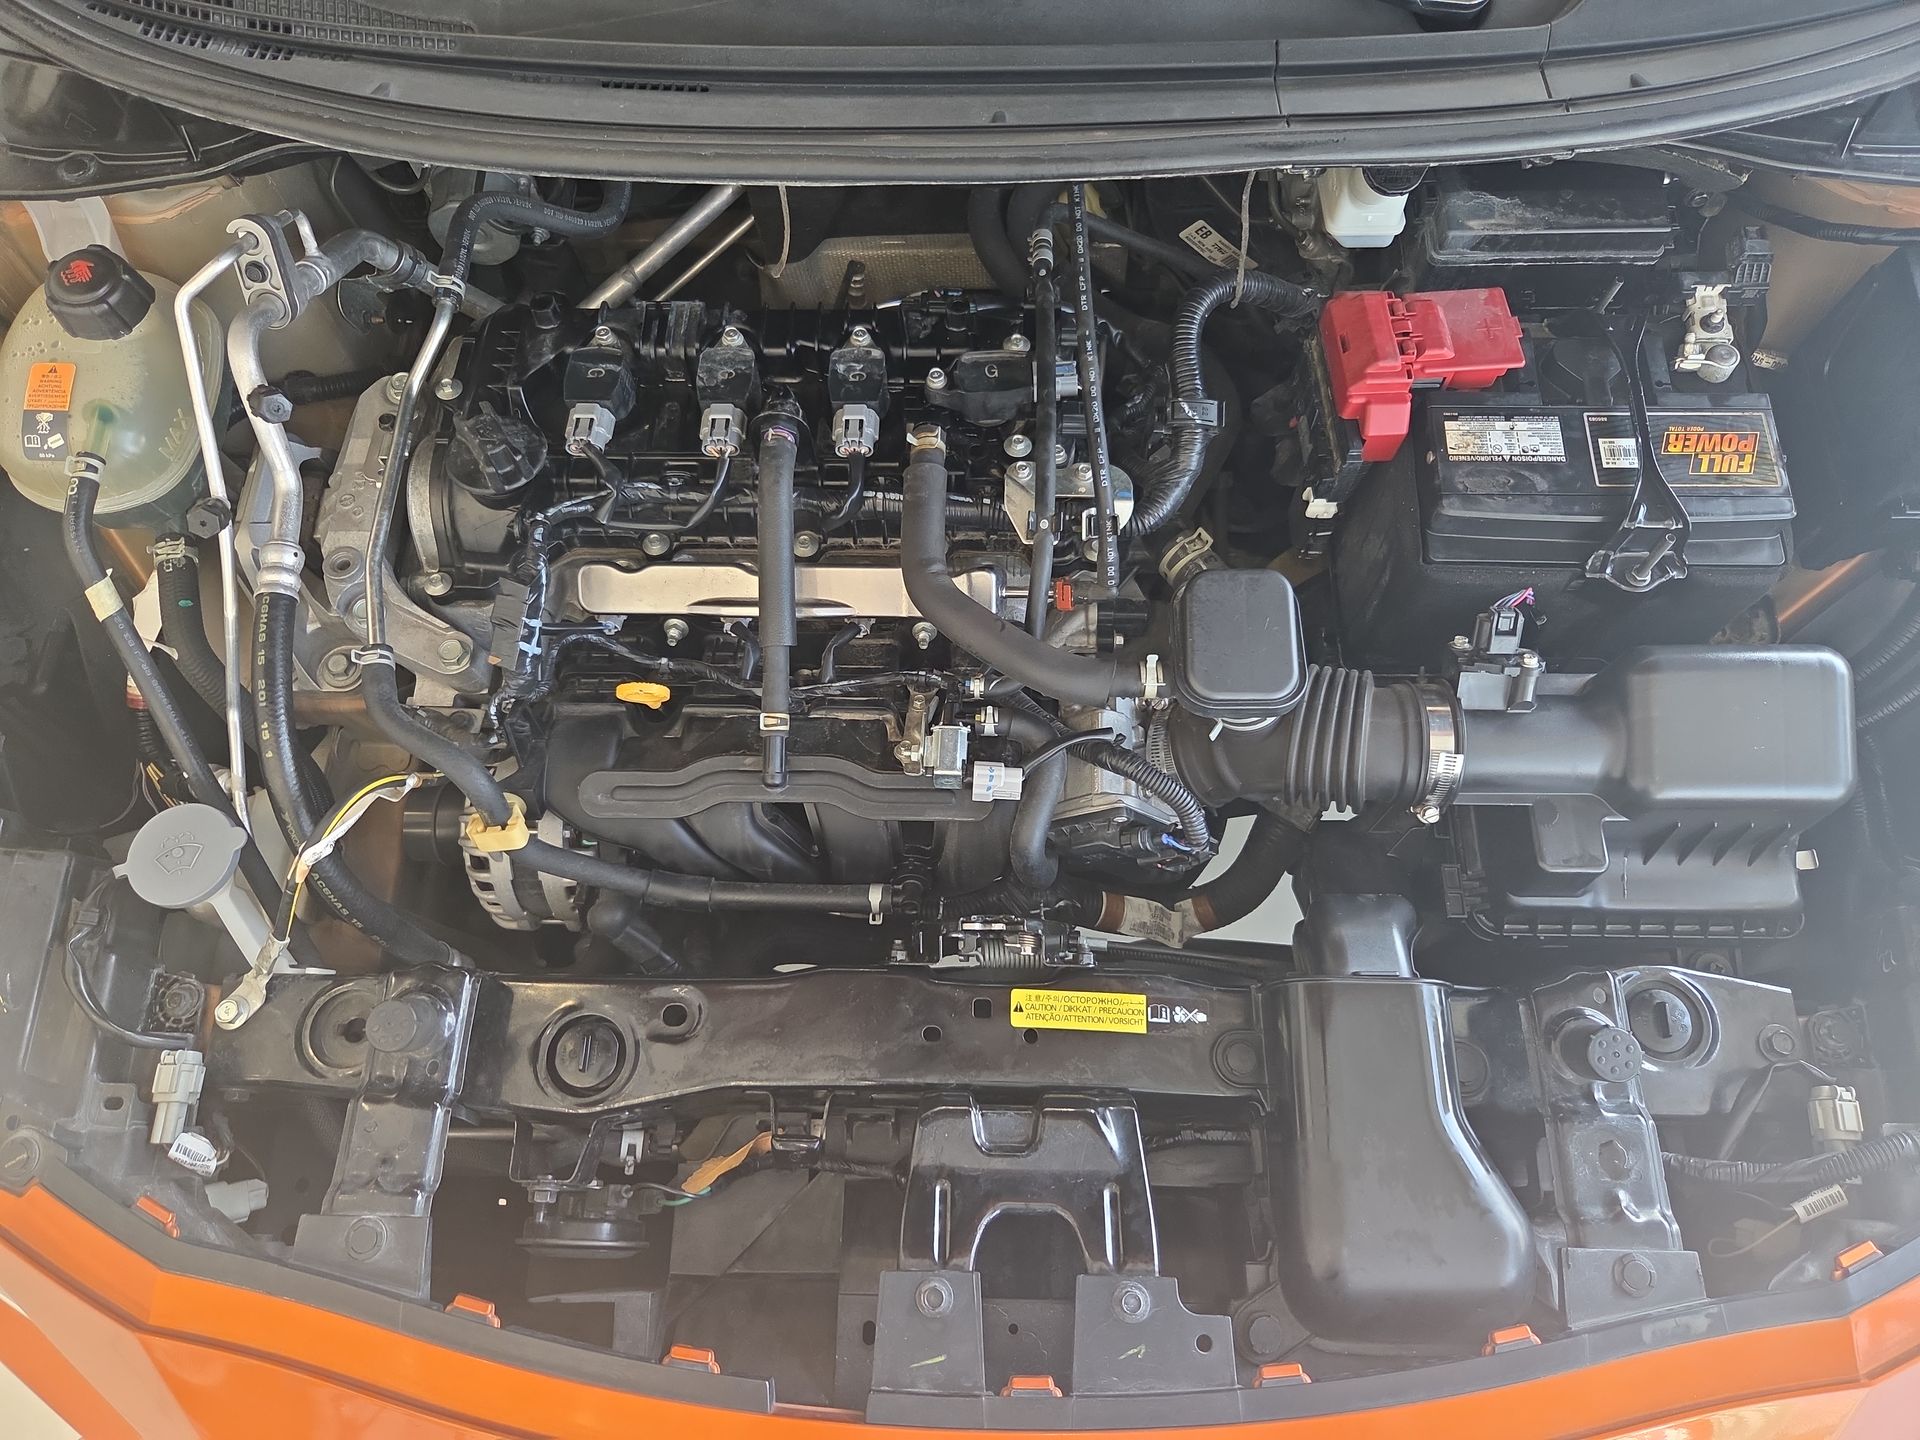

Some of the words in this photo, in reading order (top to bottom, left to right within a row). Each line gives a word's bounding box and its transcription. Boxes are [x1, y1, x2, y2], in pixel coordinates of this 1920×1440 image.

[1076, 222, 1082, 231] DO
[1194, 226, 1212, 240] EB
[1085, 340, 1093, 361] KINK
[1090, 386, 1097, 397] DO
[1667, 433, 1755, 452] POWER
[1698, 454, 1752, 472] FULL
[1108, 566, 1115, 576] DO
[1025, 1003, 1057, 1011] CAUTION
[1063, 1005, 1092, 1013] DIKKAT
